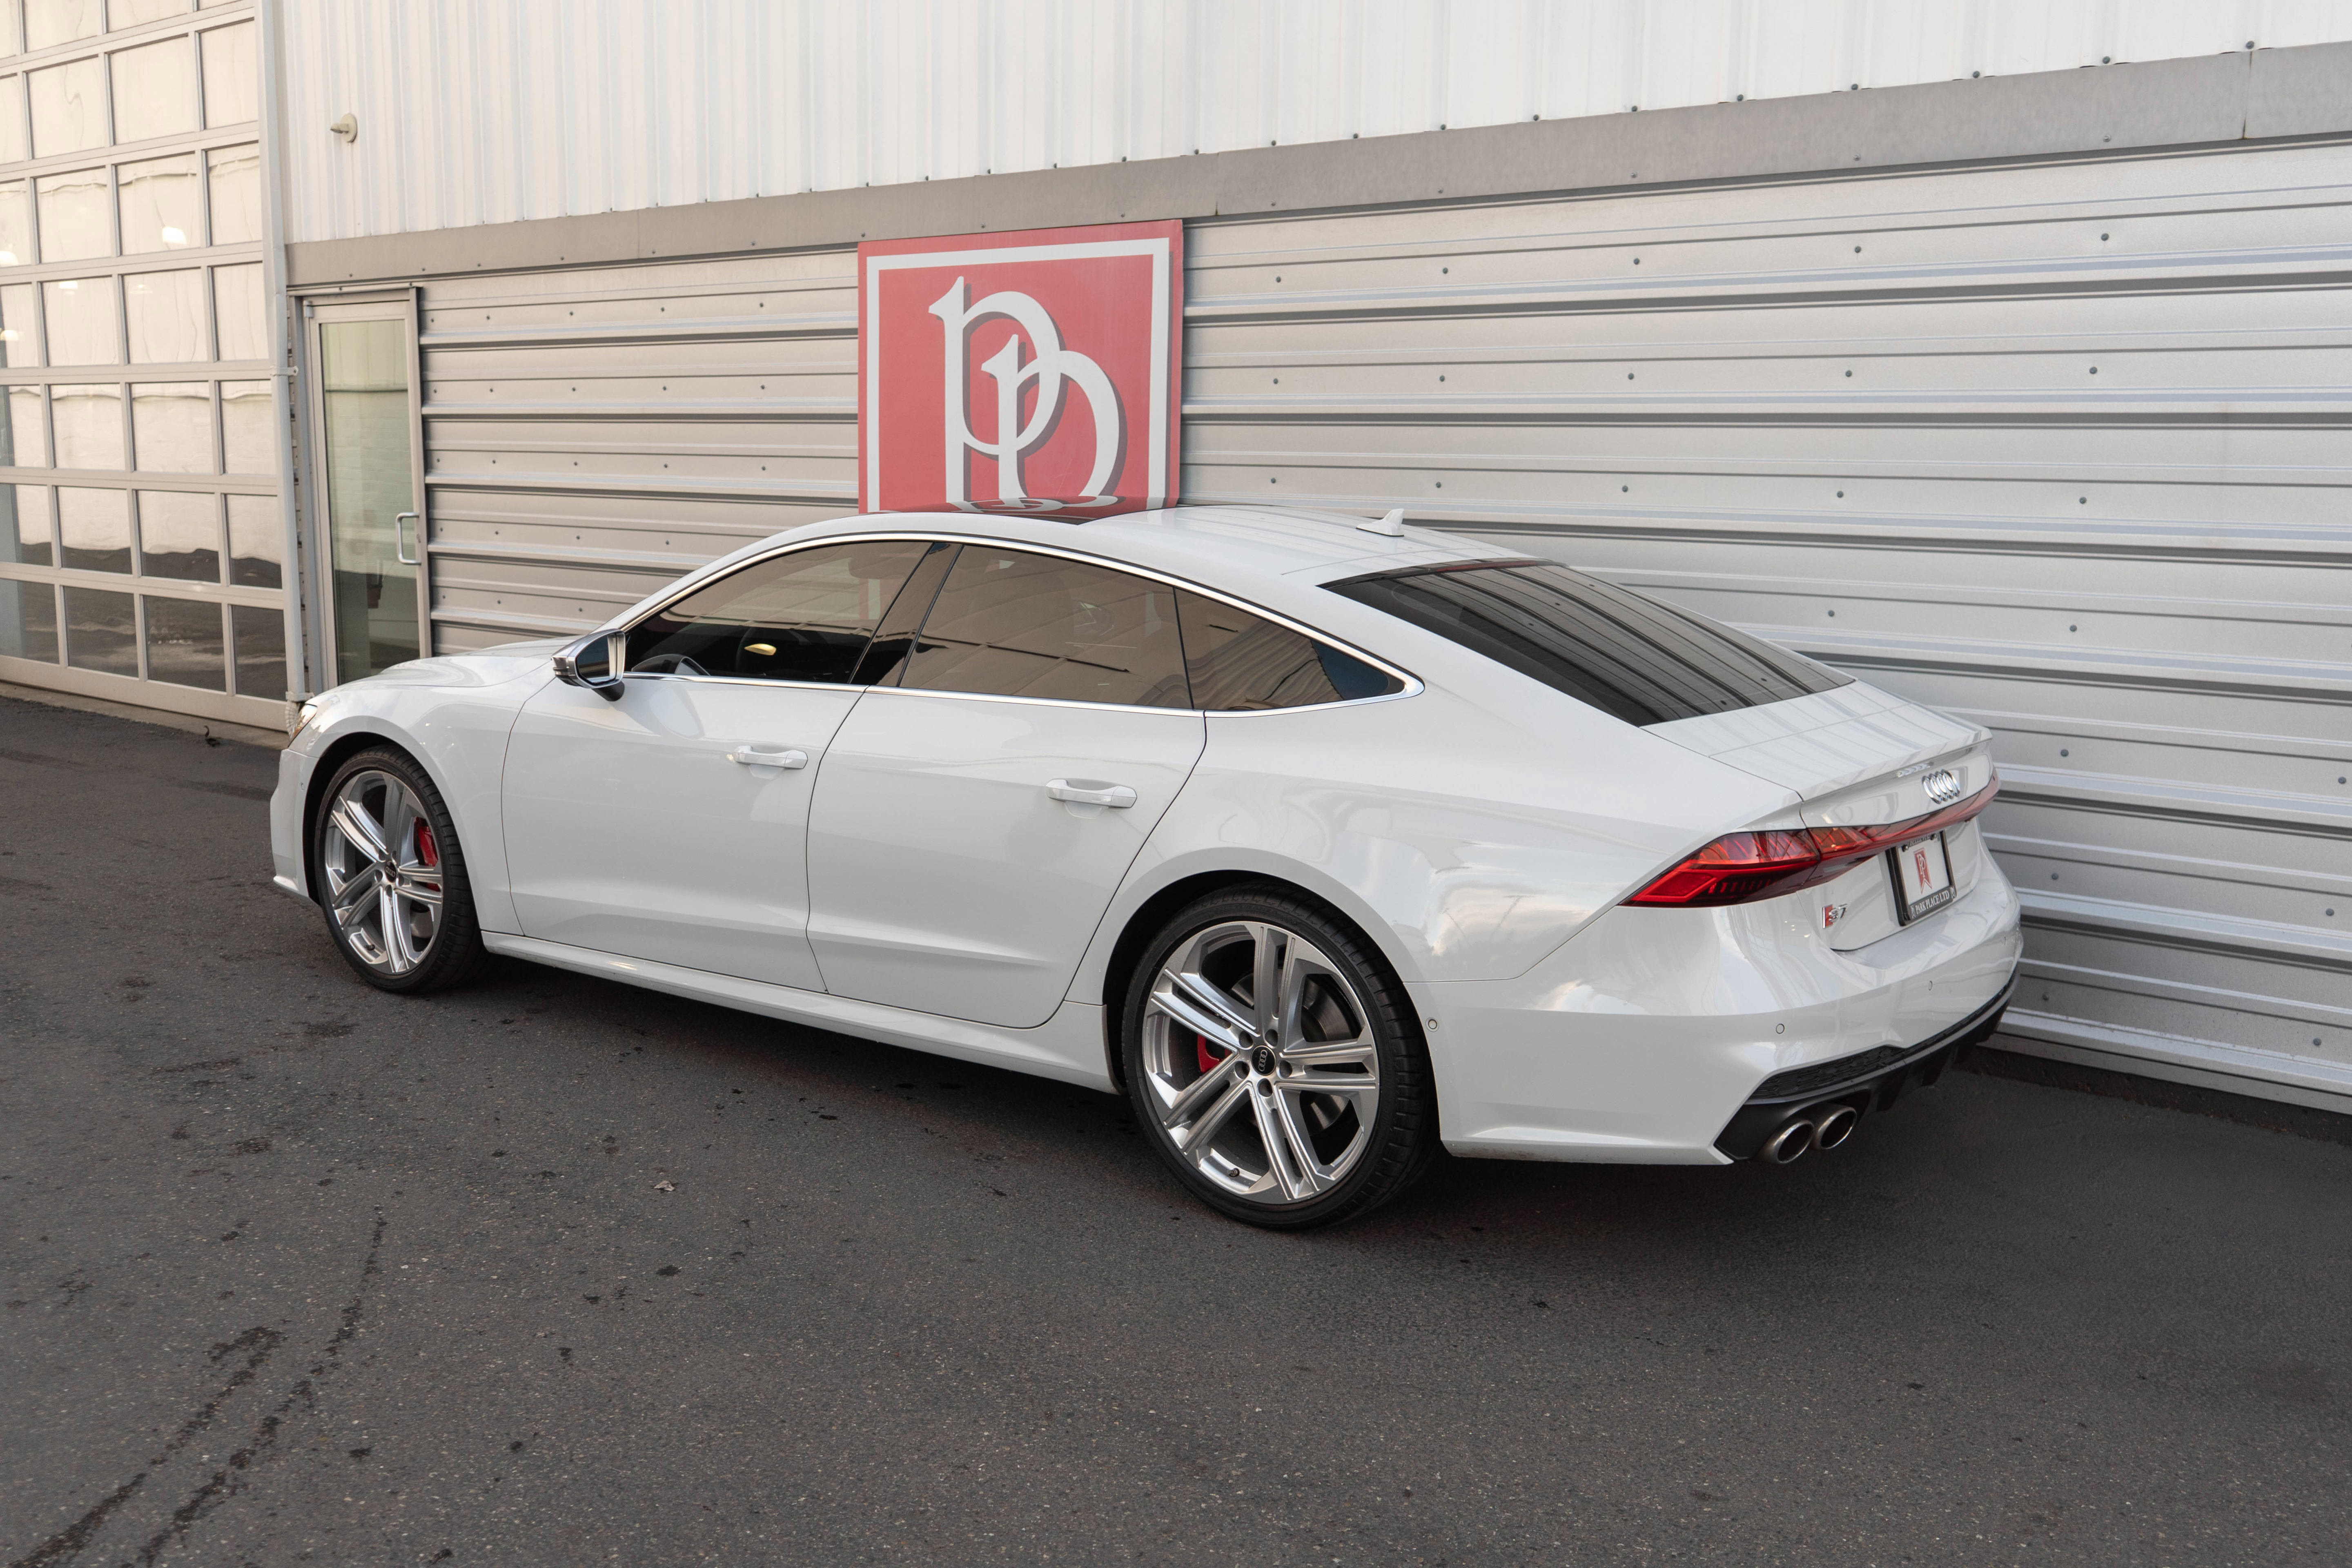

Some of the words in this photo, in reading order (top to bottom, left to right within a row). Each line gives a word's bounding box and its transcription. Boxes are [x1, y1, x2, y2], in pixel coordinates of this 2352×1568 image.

[1828, 903, 1848, 923] S7
[1915, 901, 1927, 915] PARK
[1925, 894, 1940, 909] PLACE
[1939, 890, 1950, 902] LTD
